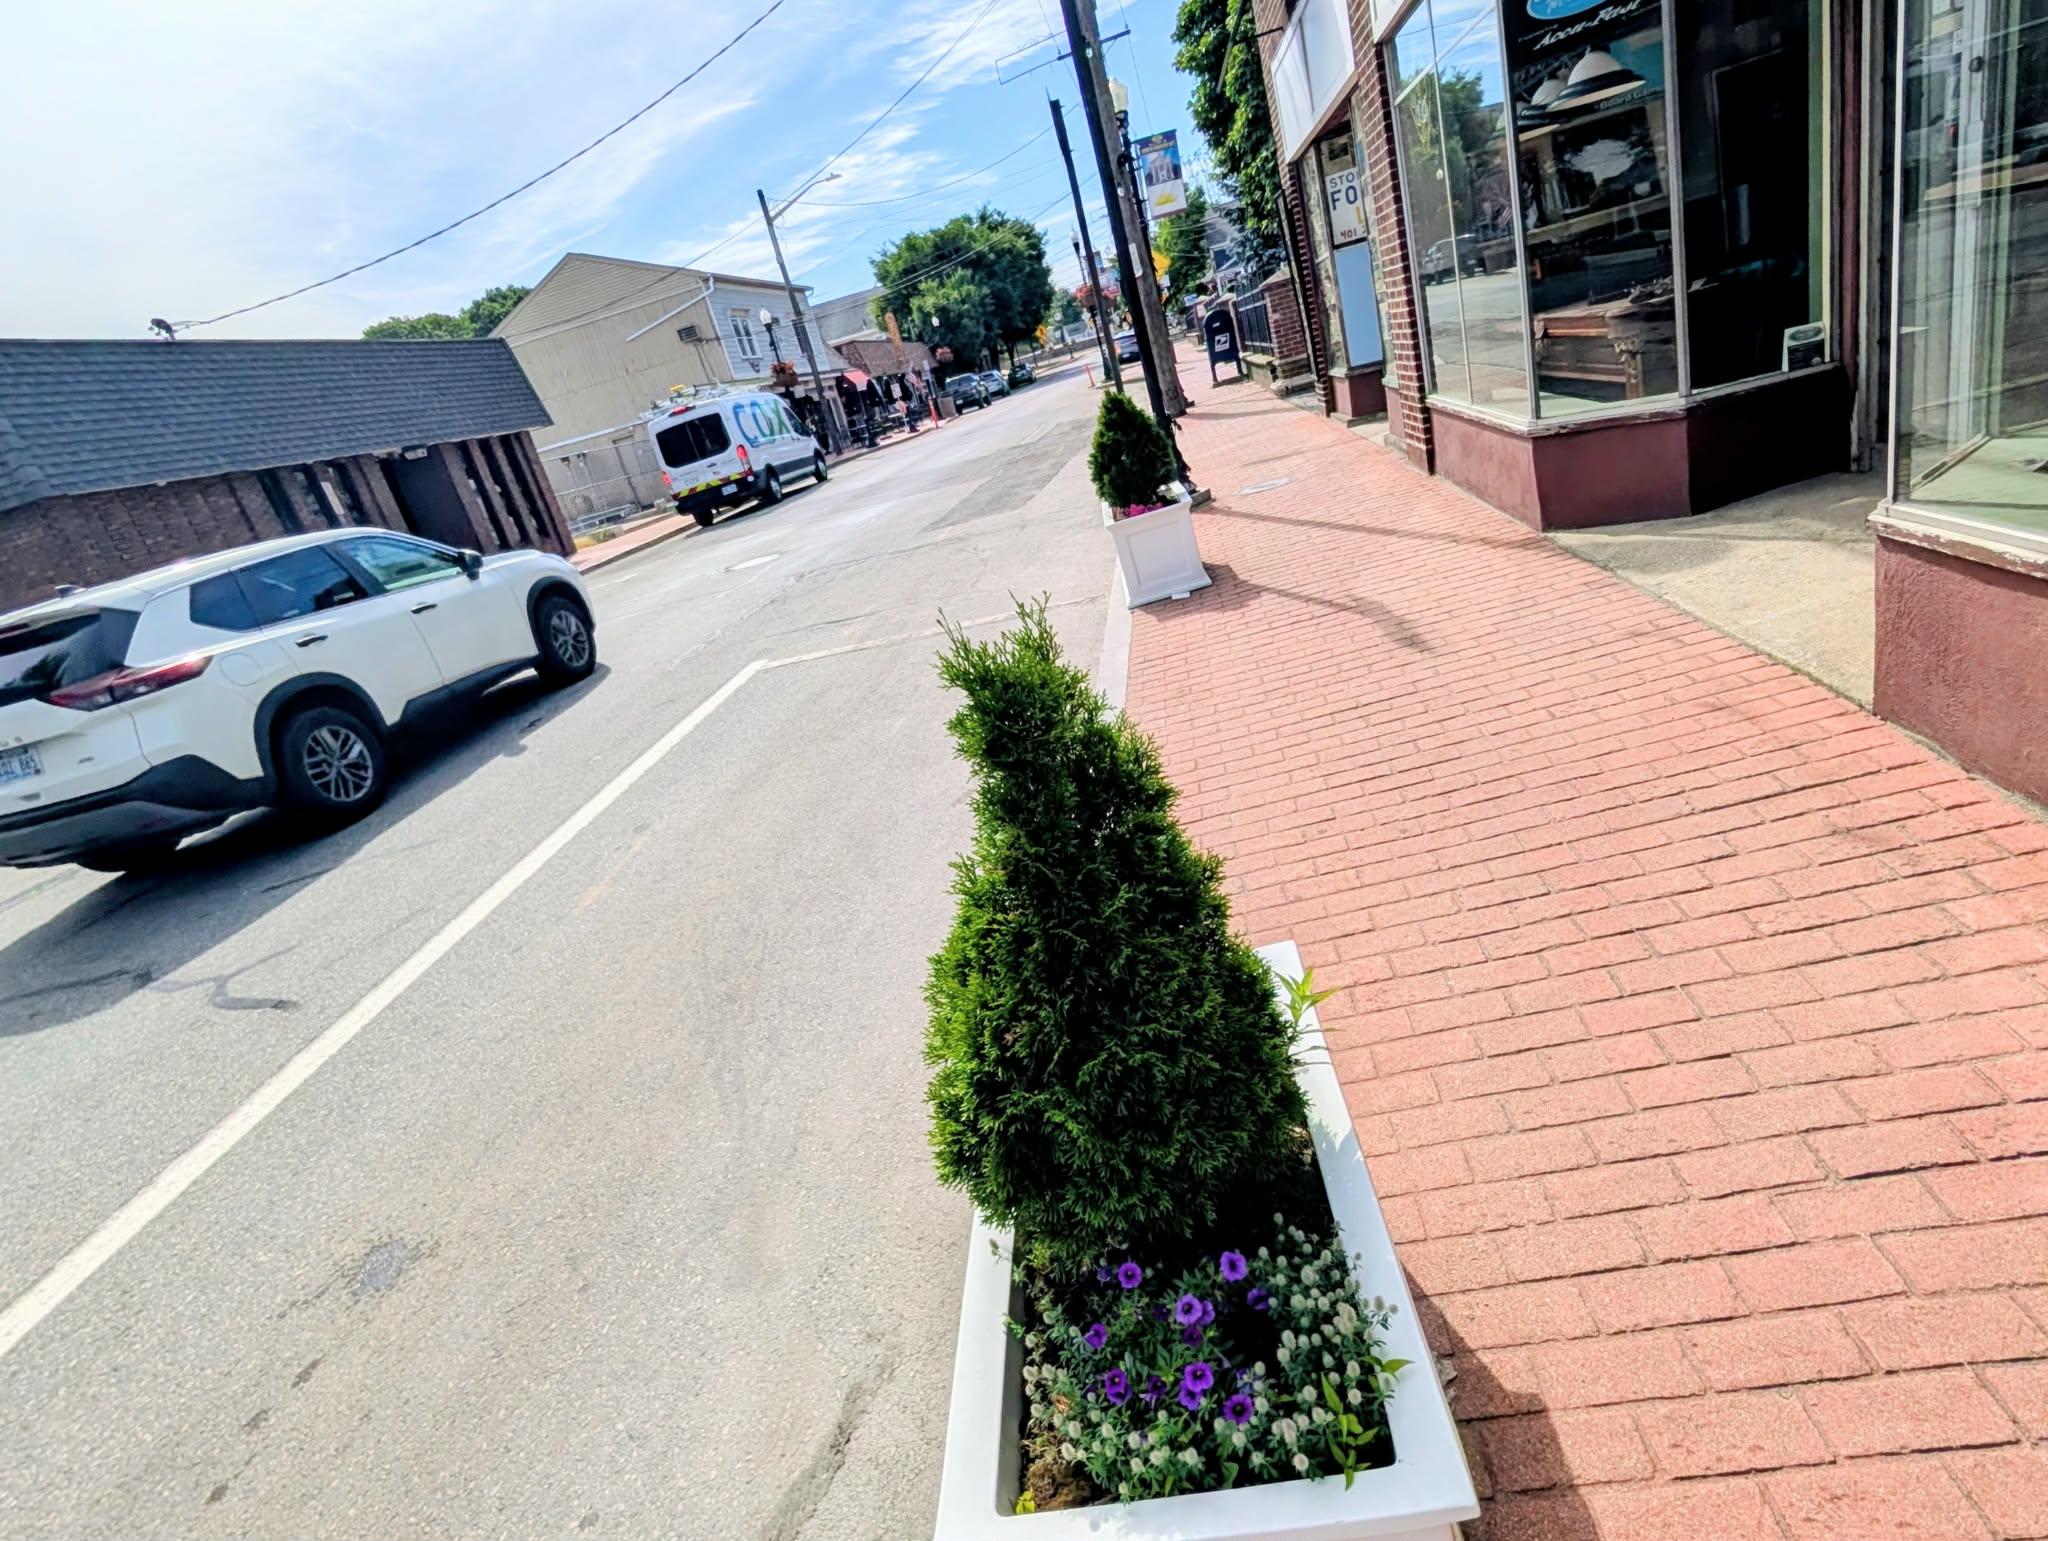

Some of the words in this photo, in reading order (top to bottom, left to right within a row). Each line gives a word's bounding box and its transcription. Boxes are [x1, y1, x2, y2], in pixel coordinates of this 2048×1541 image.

[1532, 0, 1642, 51] Accu-Fast
[1340, 228, 1357, 240] 401
[733, 399, 791, 448] COX
